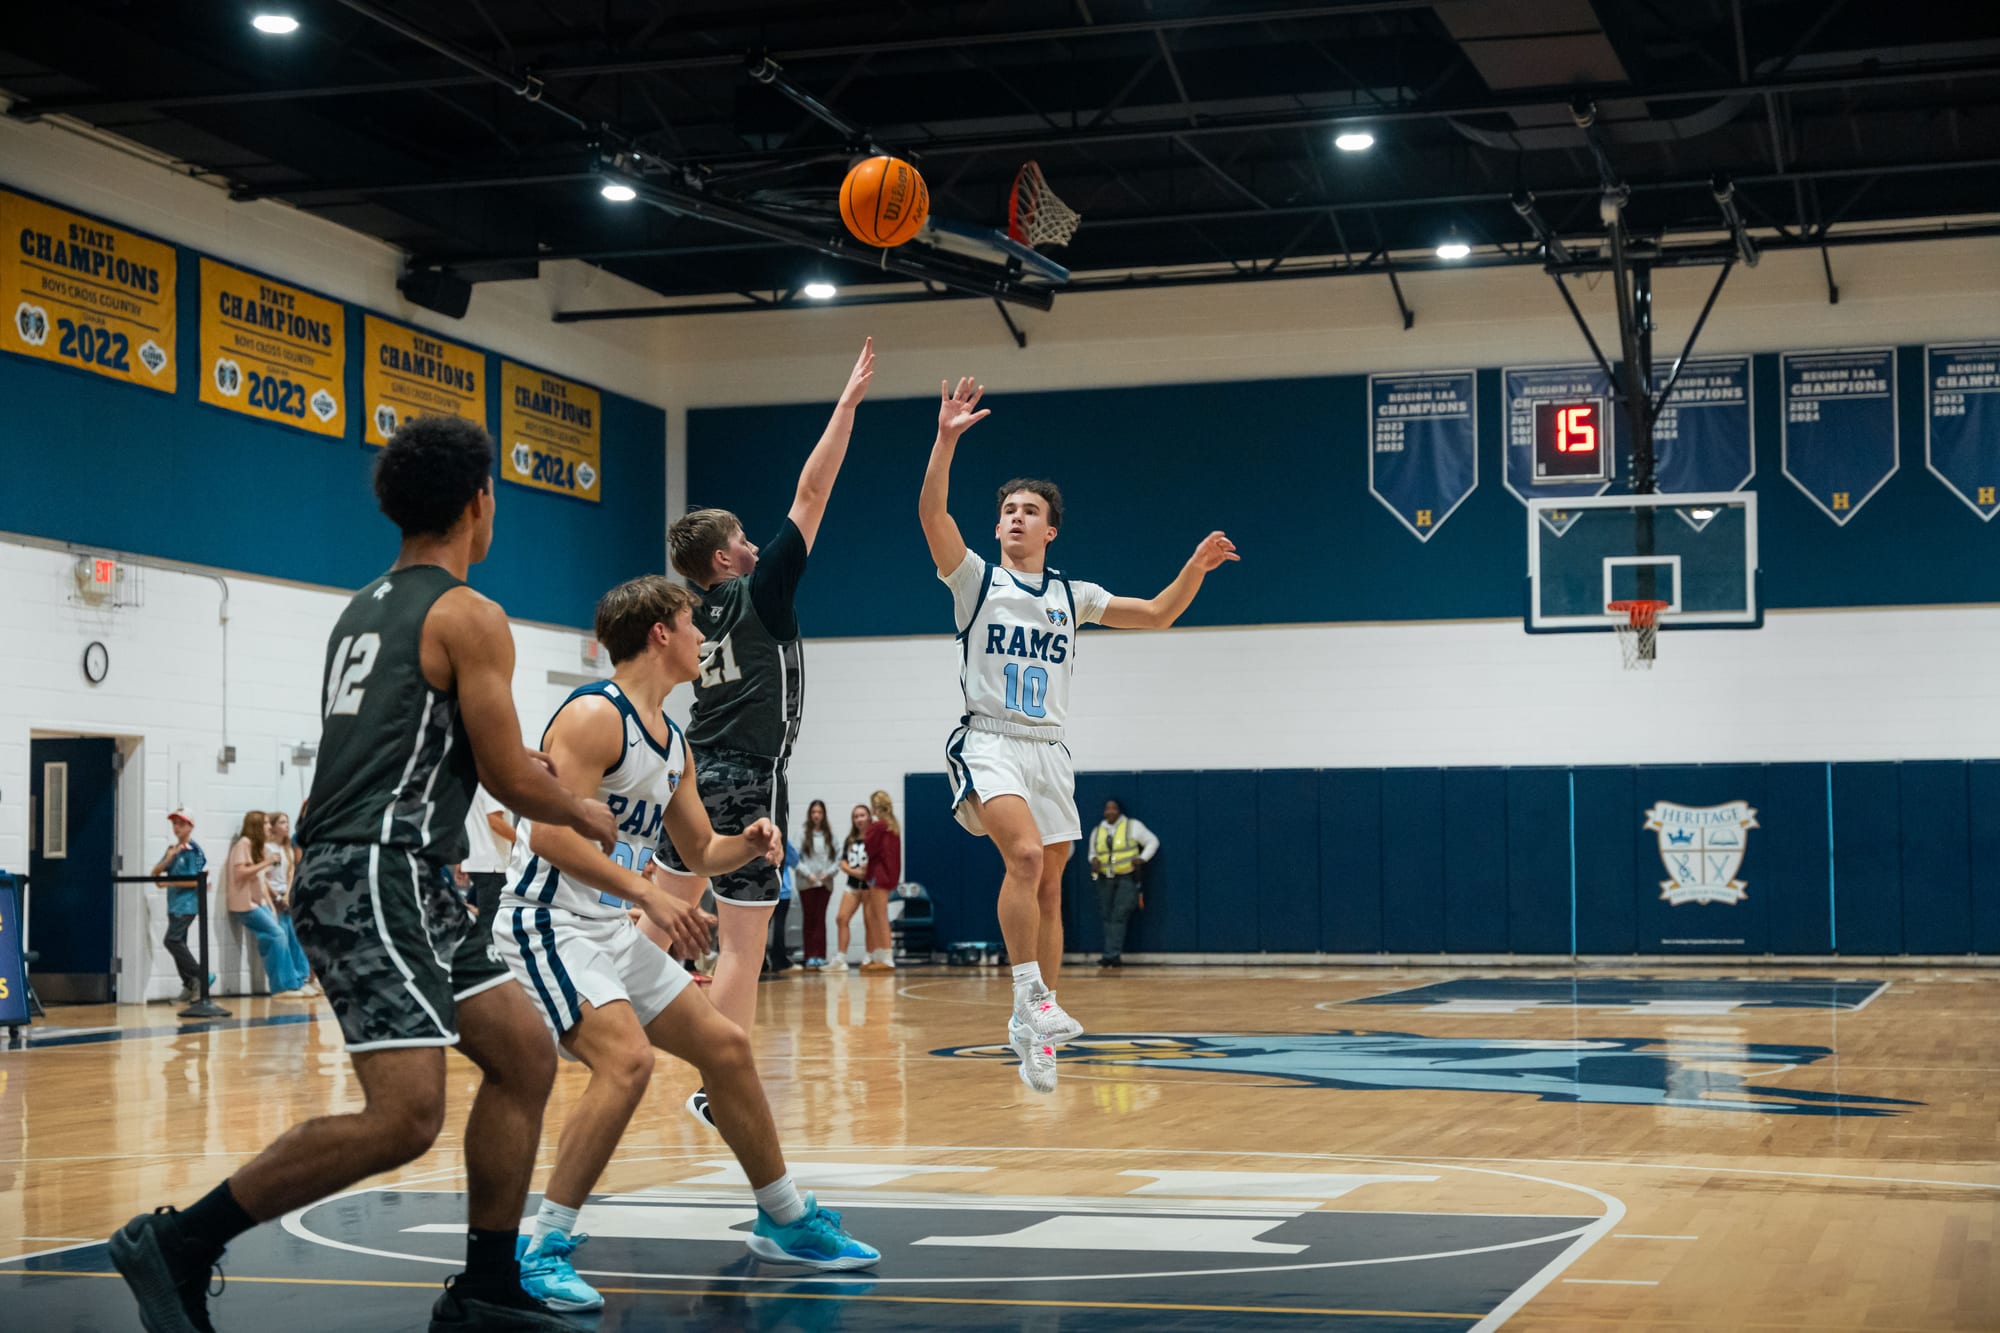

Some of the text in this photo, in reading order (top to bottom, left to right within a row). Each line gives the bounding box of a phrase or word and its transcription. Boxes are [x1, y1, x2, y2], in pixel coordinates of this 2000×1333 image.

[883, 166, 908, 221] Wilson
[69, 224, 114, 251] STATE
[20, 228, 159, 294] CHAMPIONS
[41, 276, 142, 316] BOYS CROSS COUNTRY
[260, 285, 295, 310] STATE
[220, 290, 332, 347] CHAMPIONS
[57, 318, 130, 373] 2022
[413, 336, 443, 359] STATE
[380, 343, 475, 392] CHAMPIONS
[1802, 369, 1849, 381] REGION
[1947, 362, 1995, 374] REGION
[247, 370, 306, 419] 2023
[1523, 384, 1567, 396] REGION
[1651, 386, 1743, 402] CAMPIONS
[1660, 377, 1706, 390] RGION
[1791, 379, 1887, 396] CHAMPIONS
[1936, 374, 2000, 389] CHAMPI
[515, 385, 592, 429] CHAMPIONS
[1378, 401, 1467, 416] CHAMPIONS
[1388, 391, 1432, 403] REGION
[1557, 408, 1595, 452] 15
[532, 450, 575, 490] 2024
[1832, 492, 1849, 510] H
[1978, 486, 1995, 505] H
[1416, 509, 1432, 527] H
[985, 623, 1068, 664] RAMS
[699, 632, 742, 688] 21
[325, 632, 381, 720] 12
[1004, 662, 1048, 719] 10
[1662, 807, 1739, 825] HERITAGE
